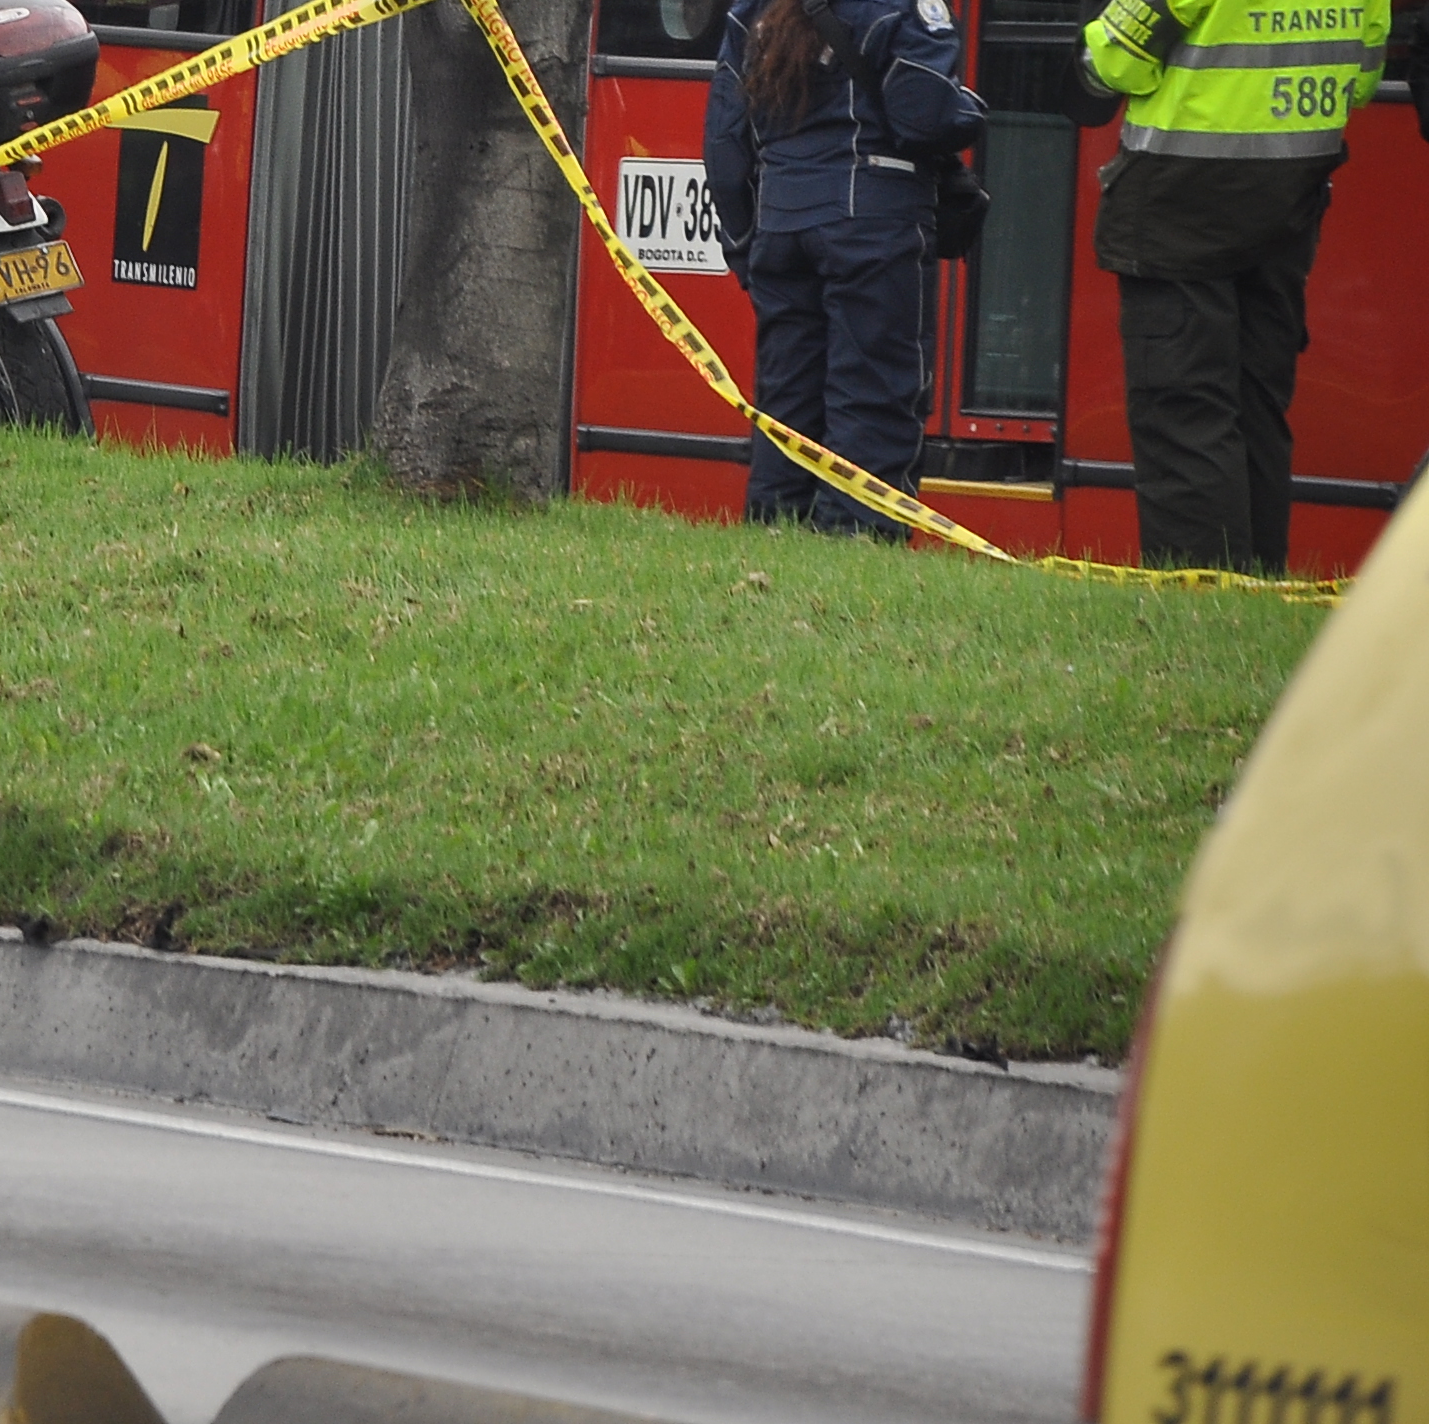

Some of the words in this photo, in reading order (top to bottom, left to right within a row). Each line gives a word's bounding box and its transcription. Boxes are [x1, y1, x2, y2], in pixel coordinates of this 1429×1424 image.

[1271, 75, 1357, 119] 5881
[638, 248, 684, 262] BOGOTA
[113, 259, 196, 287] TRANSMILENIO
